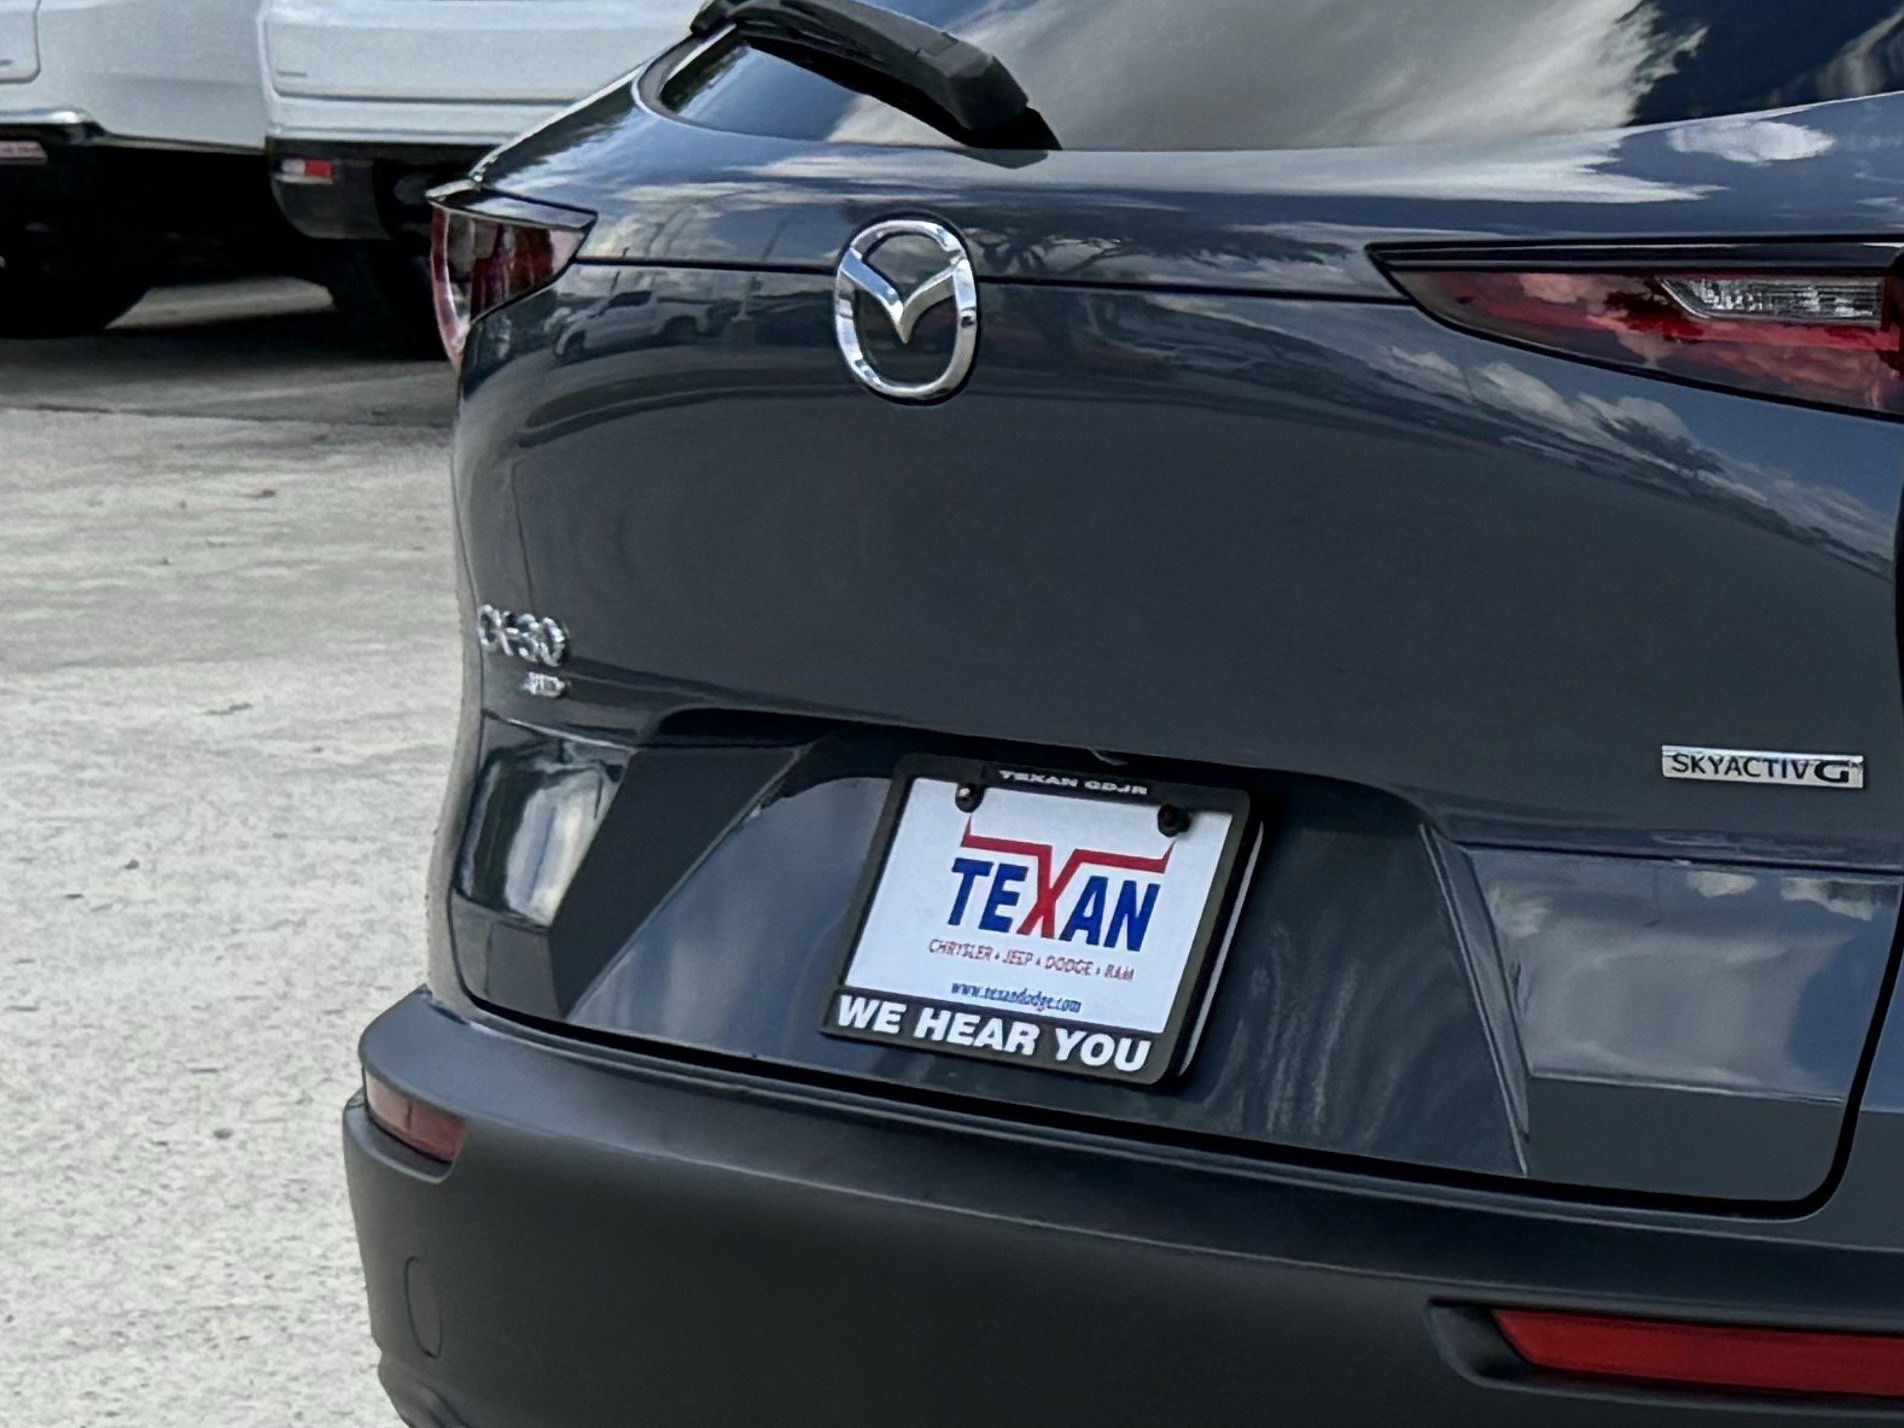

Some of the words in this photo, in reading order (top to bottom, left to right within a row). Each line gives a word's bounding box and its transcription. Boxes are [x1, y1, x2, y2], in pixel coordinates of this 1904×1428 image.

[998, 770, 1079, 788] TEXAN
[1671, 752, 1810, 780] SKYACTIV
[1813, 759, 1852, 784] G
[947, 816, 1176, 952] TEXAN
[928, 938, 994, 962] CHRYSLER
[1002, 948, 1034, 967] JEEP
[1044, 954, 1094, 977] DODGE
[1103, 963, 1135, 983] RAM
[837, 995, 907, 1034] WE
[913, 1007, 1041, 1057] HEAR
[1054, 1028, 1152, 1072] YOU
